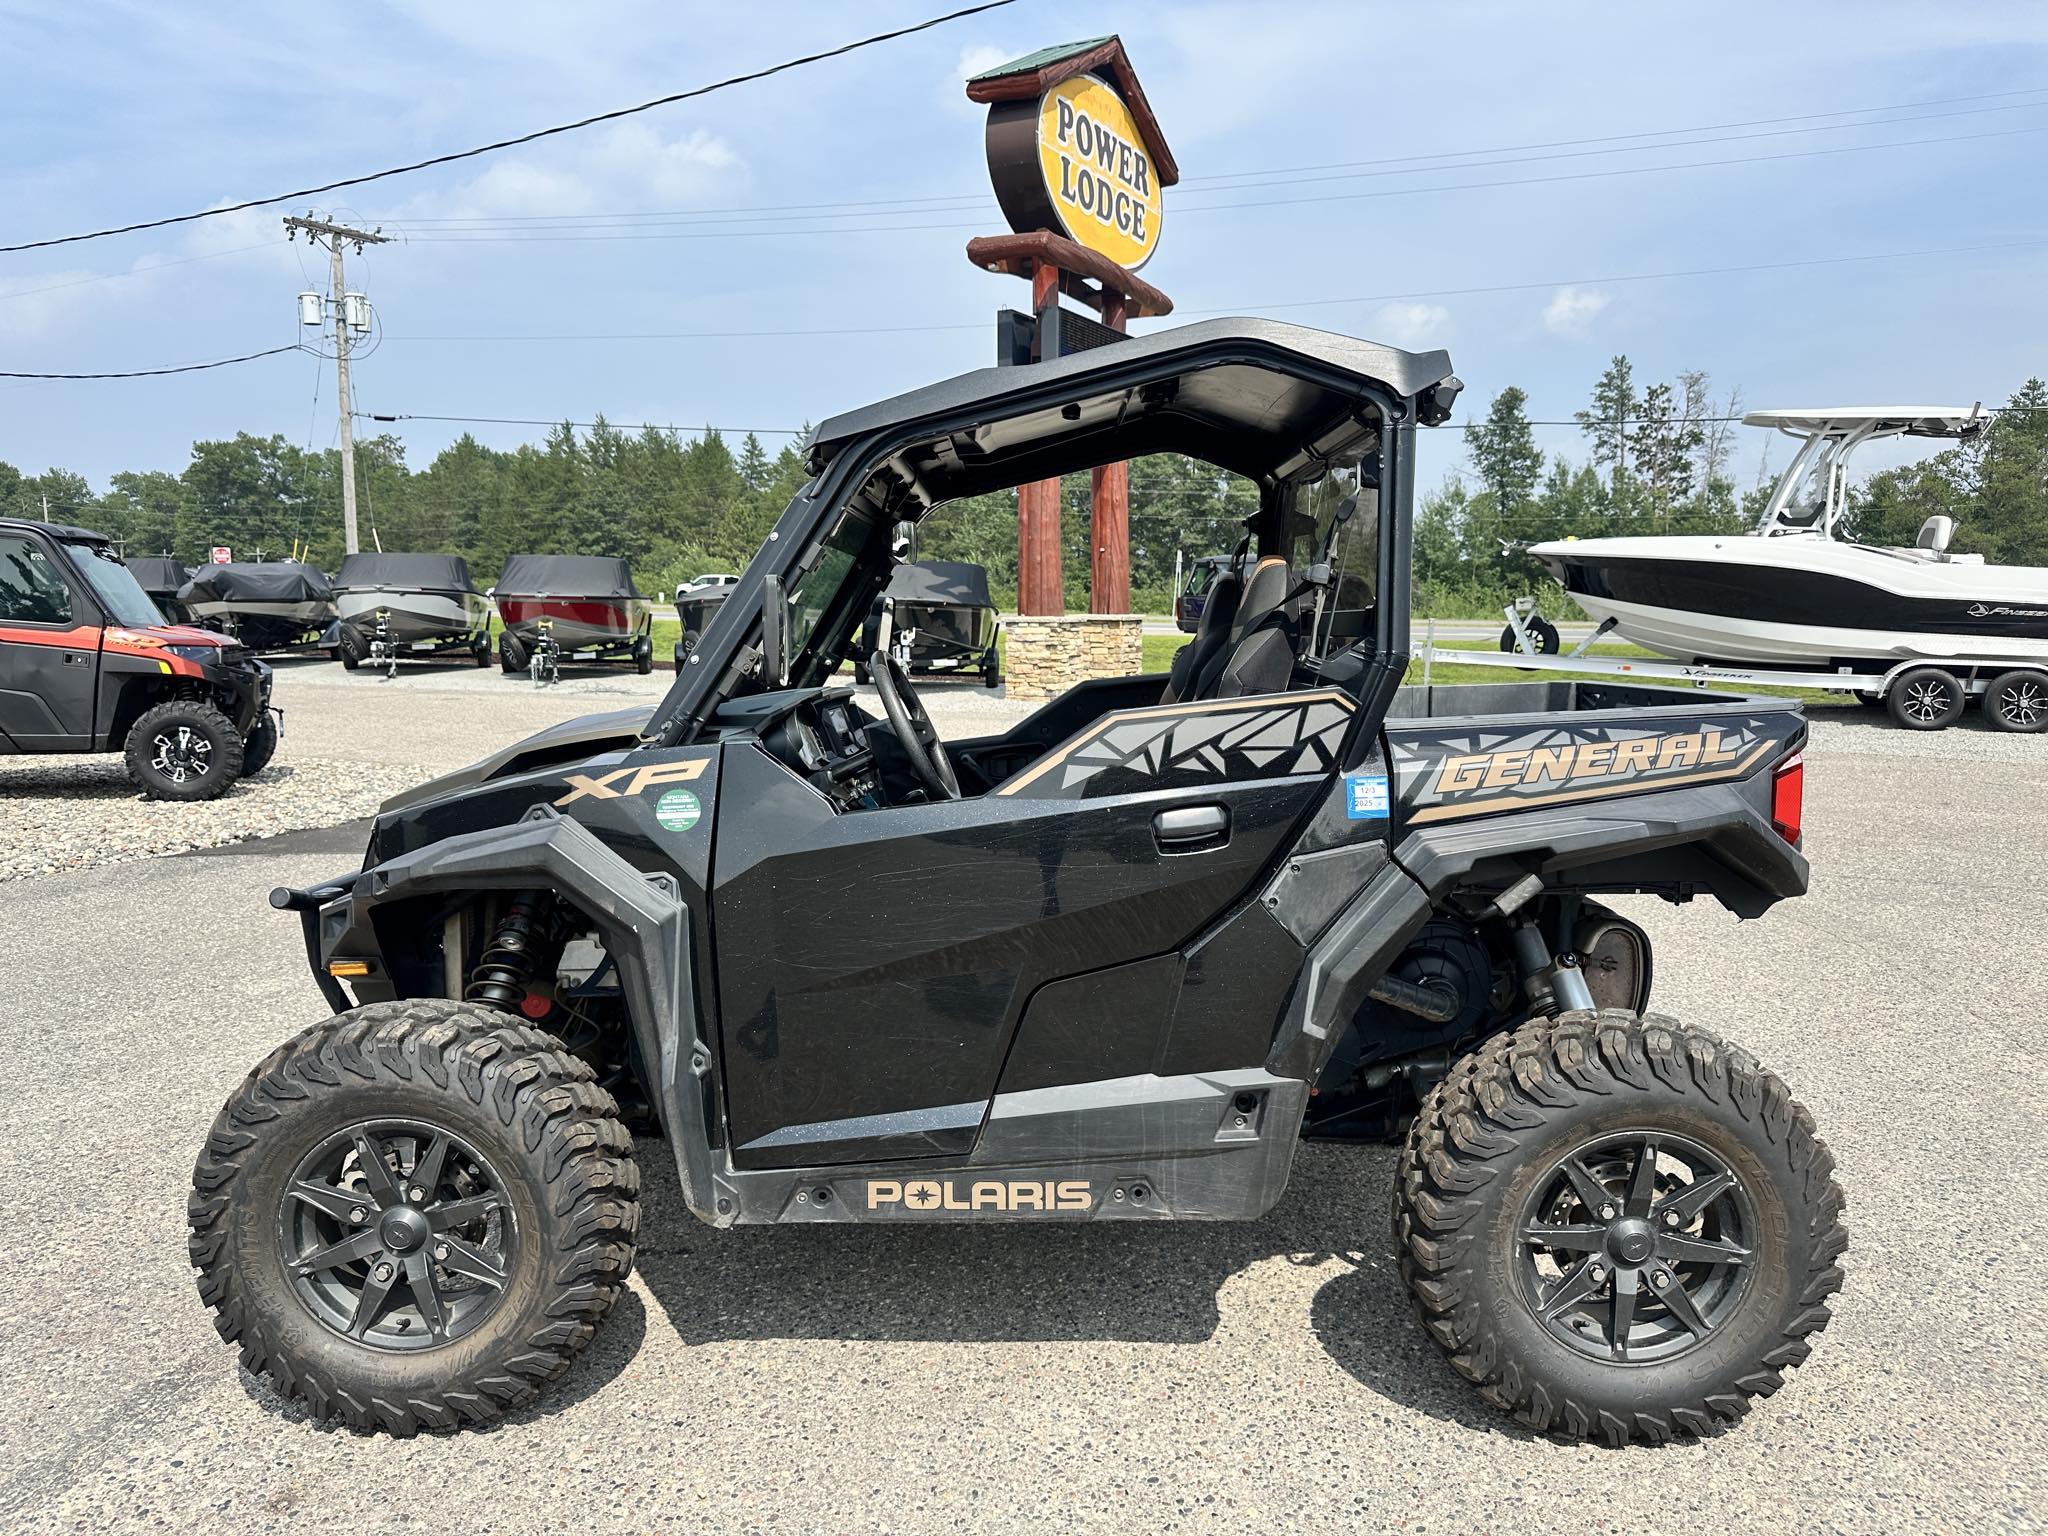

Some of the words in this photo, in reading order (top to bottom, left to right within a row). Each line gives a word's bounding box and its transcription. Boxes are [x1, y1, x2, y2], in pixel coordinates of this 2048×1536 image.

[1057, 98, 1149, 197] POWER
[1060, 155, 1147, 242] LODGE
[553, 758, 712, 806] XP
[1434, 731, 1739, 795] GENERAL
[866, 1180, 1093, 1211] POLARIS
